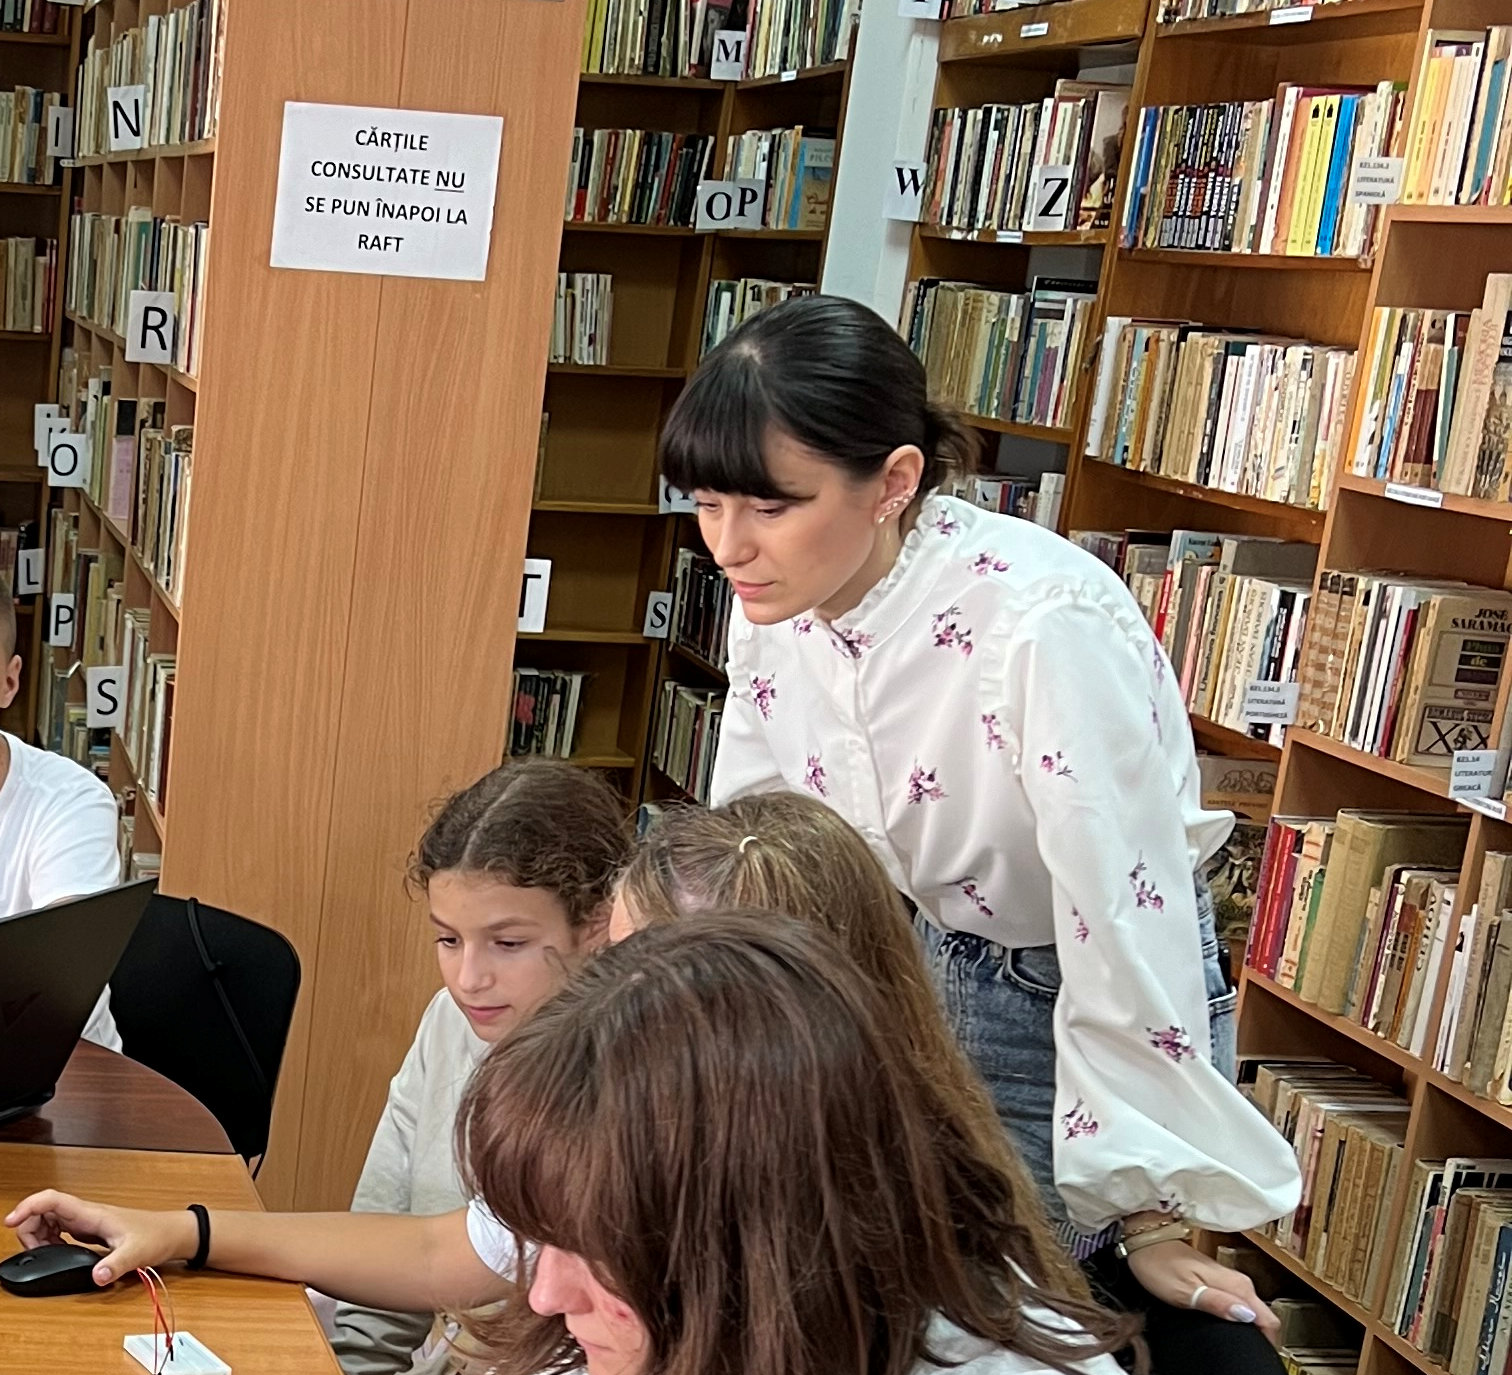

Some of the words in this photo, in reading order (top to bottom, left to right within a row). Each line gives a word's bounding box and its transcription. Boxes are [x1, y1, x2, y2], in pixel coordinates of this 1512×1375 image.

[716, 38, 744, 63] M
[113, 98, 140, 139] N
[355, 126, 429, 152] CĂRȚILE
[311, 161, 430, 185] CONSULTATE
[435, 171, 465, 190] NU
[895, 167, 926, 197] W
[305, 196, 325, 213] SE
[332, 199, 370, 217] PUN
[376, 198, 440, 223] ÎNAPOI
[447, 208, 467, 225] LA
[705, 191, 732, 221] O
[735, 187, 758, 217] P
[1038, 178, 1068, 217] Z
[358, 234, 403, 252] RAFT
[141, 306, 168, 351] R
[51, 444, 78, 476] O
[26, 558, 39, 585] L
[55, 605, 73, 636] P
[650, 601, 668, 629] S
[96, 678, 118, 715] S
